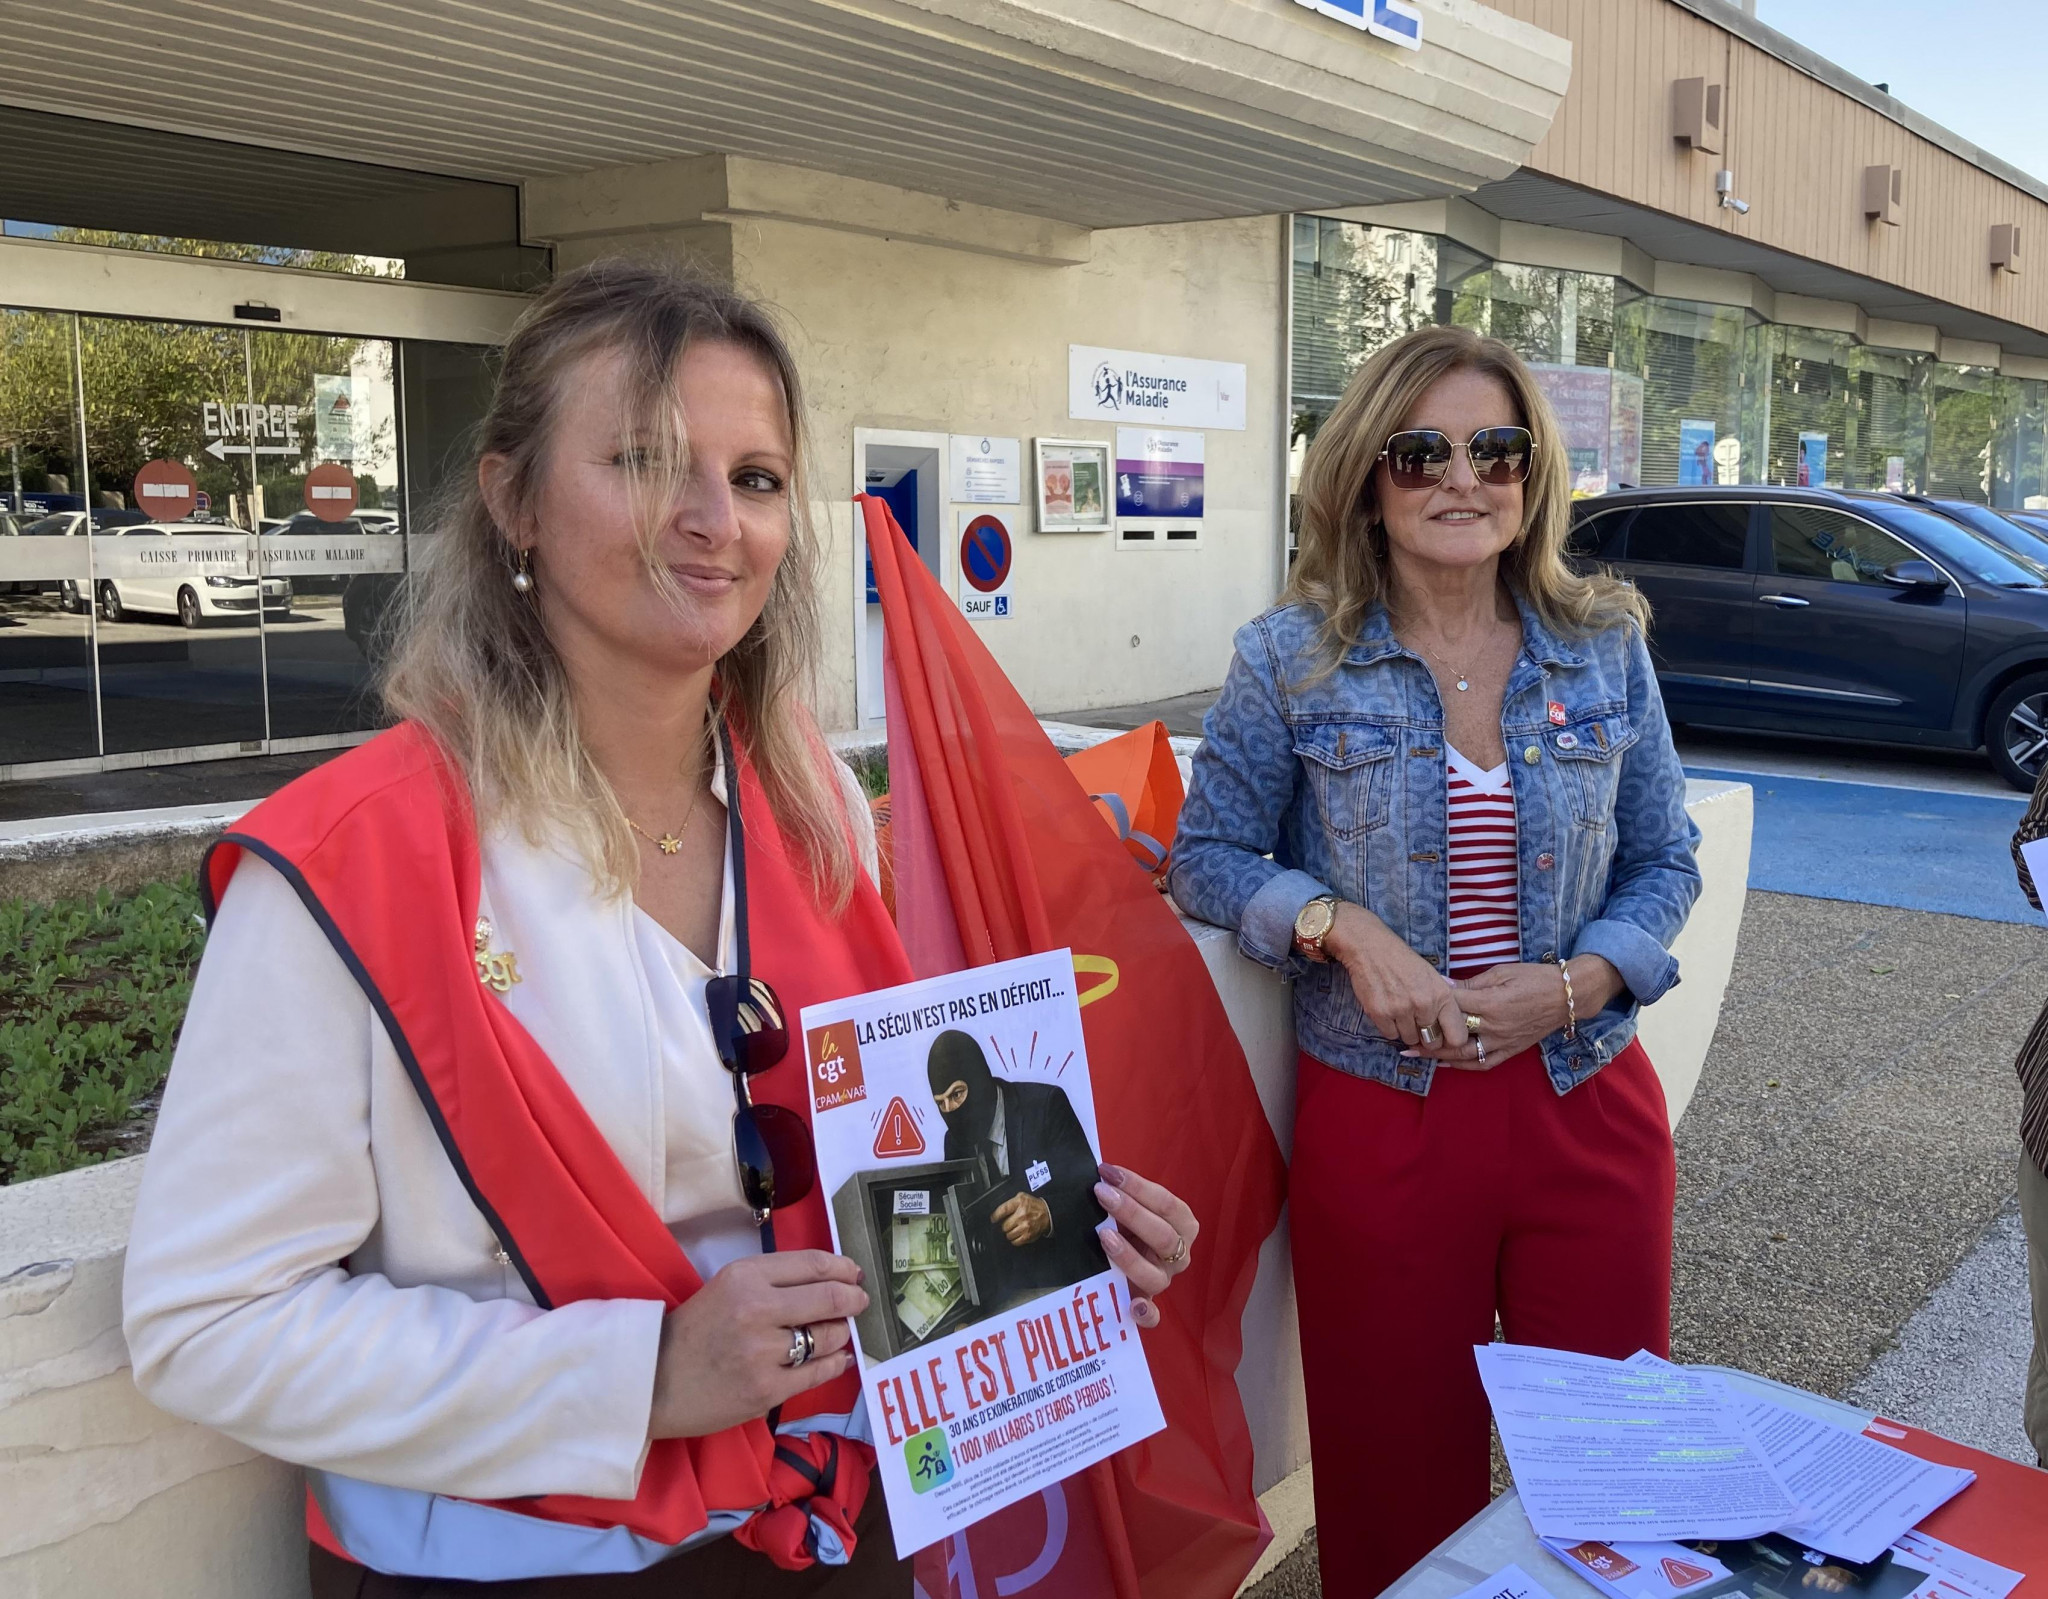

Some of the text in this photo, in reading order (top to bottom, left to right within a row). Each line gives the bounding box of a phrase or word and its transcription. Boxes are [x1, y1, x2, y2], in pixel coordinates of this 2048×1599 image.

[1125, 370, 1187, 392] l'Assurance
[1125, 390, 1169, 408] Maladie
[203, 402, 301, 438] ENTREE
[140, 551, 178, 563] CAISSE
[188, 550, 237, 563] PRIMAIRE
[262, 549, 316, 562] ASSURANCE
[325, 548, 365, 561] MALADIE
[965, 600, 991, 613] SAUF
[856, 978, 1065, 1046] LA SÉCU N'EST PAS EN DÉFICIT...
[817, 1055, 847, 1083] cgt
[1028, 1166, 1049, 1182] PLFSS
[898, 1191, 924, 1200] Sécurité
[900, 1200, 923, 1208] Sociale
[877, 1282, 1127, 1446] ELLE EST PILLÉE !
[948, 1421, 961, 1439] 30
[963, 1414, 980, 1434] ANS
[1045, 1379, 1056, 1396] DE
[1055, 1358, 1101, 1391] COTISATIONS
[982, 1411, 1036, 1455] MILLIARDS
[1035, 1393, 1076, 1430] D'EUROS
[1074, 1377, 1111, 1411] PERDUS
[1109, 1373, 1117, 1395] !
[1588, 1555, 1613, 1570] cgt
